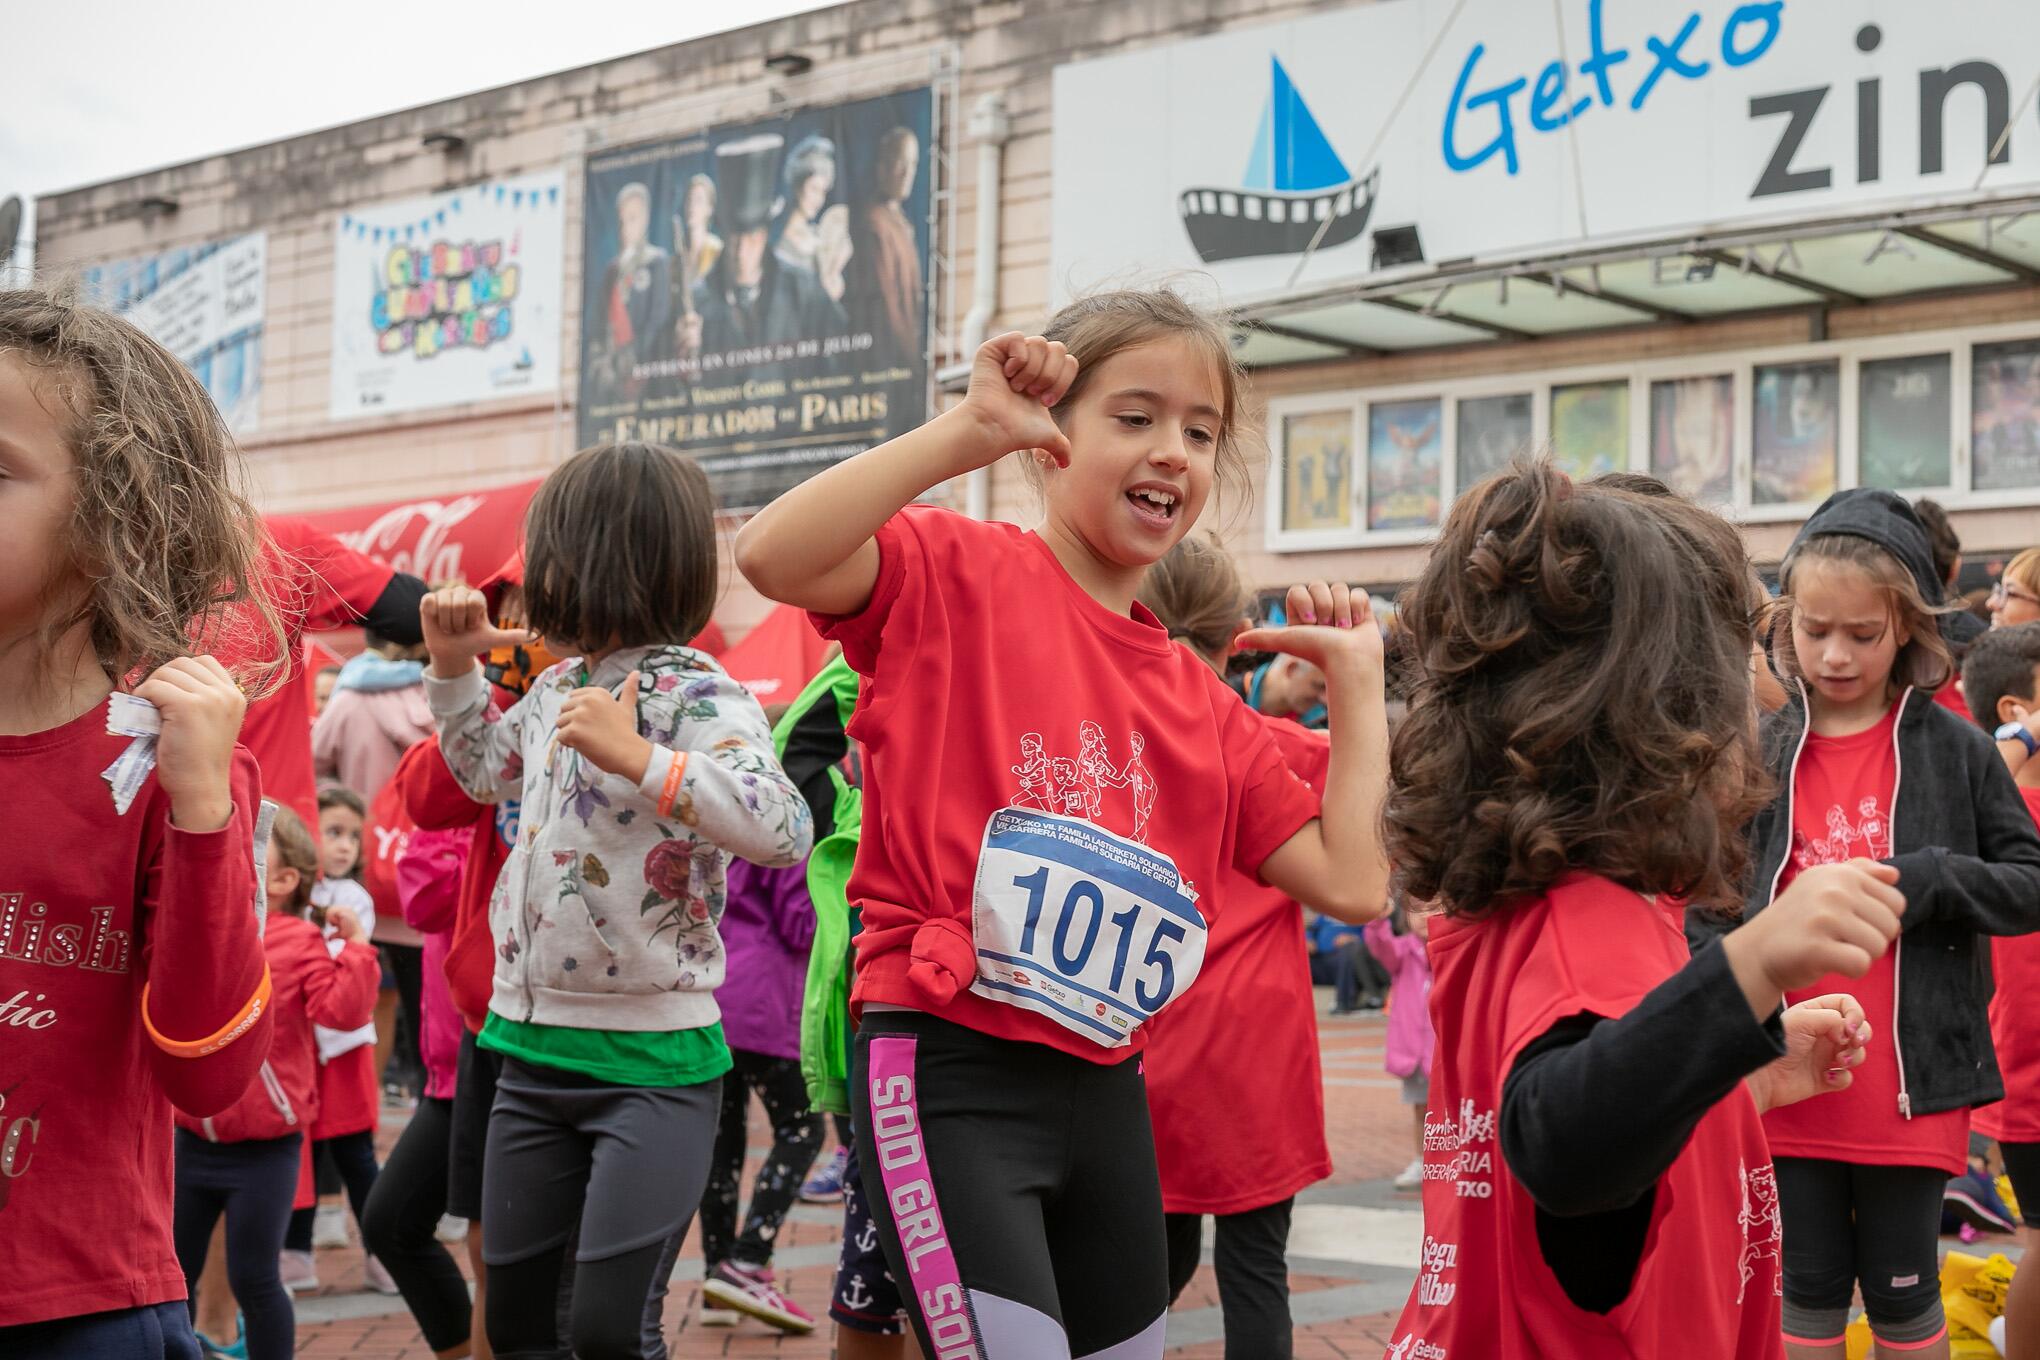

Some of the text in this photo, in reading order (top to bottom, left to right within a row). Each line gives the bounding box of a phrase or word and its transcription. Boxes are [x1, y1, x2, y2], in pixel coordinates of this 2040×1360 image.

[1441, 0, 1784, 176] Getxo
[1749, 24, 2040, 199] zin
[800, 391, 888, 432] PARIS
[1009, 823, 1057, 839] CARRERA
[1057, 833, 1099, 854] FAMILIAR
[1098, 848, 1141, 872] SOLIDARIA
[1141, 865, 1153, 877] DE
[1152, 872, 1176, 889] GETXO
[1057, 825, 1090, 842] FAMILIA
[1091, 834, 1138, 862] LASTERKETA
[1138, 856, 1177, 882] SOLIDARIOA
[1013, 866, 1187, 1013] 1015
[217, 1006, 262, 1047] CORREO
[1456, 1180, 1493, 1199] TXO
[891, 1177, 947, 1274] GRL
